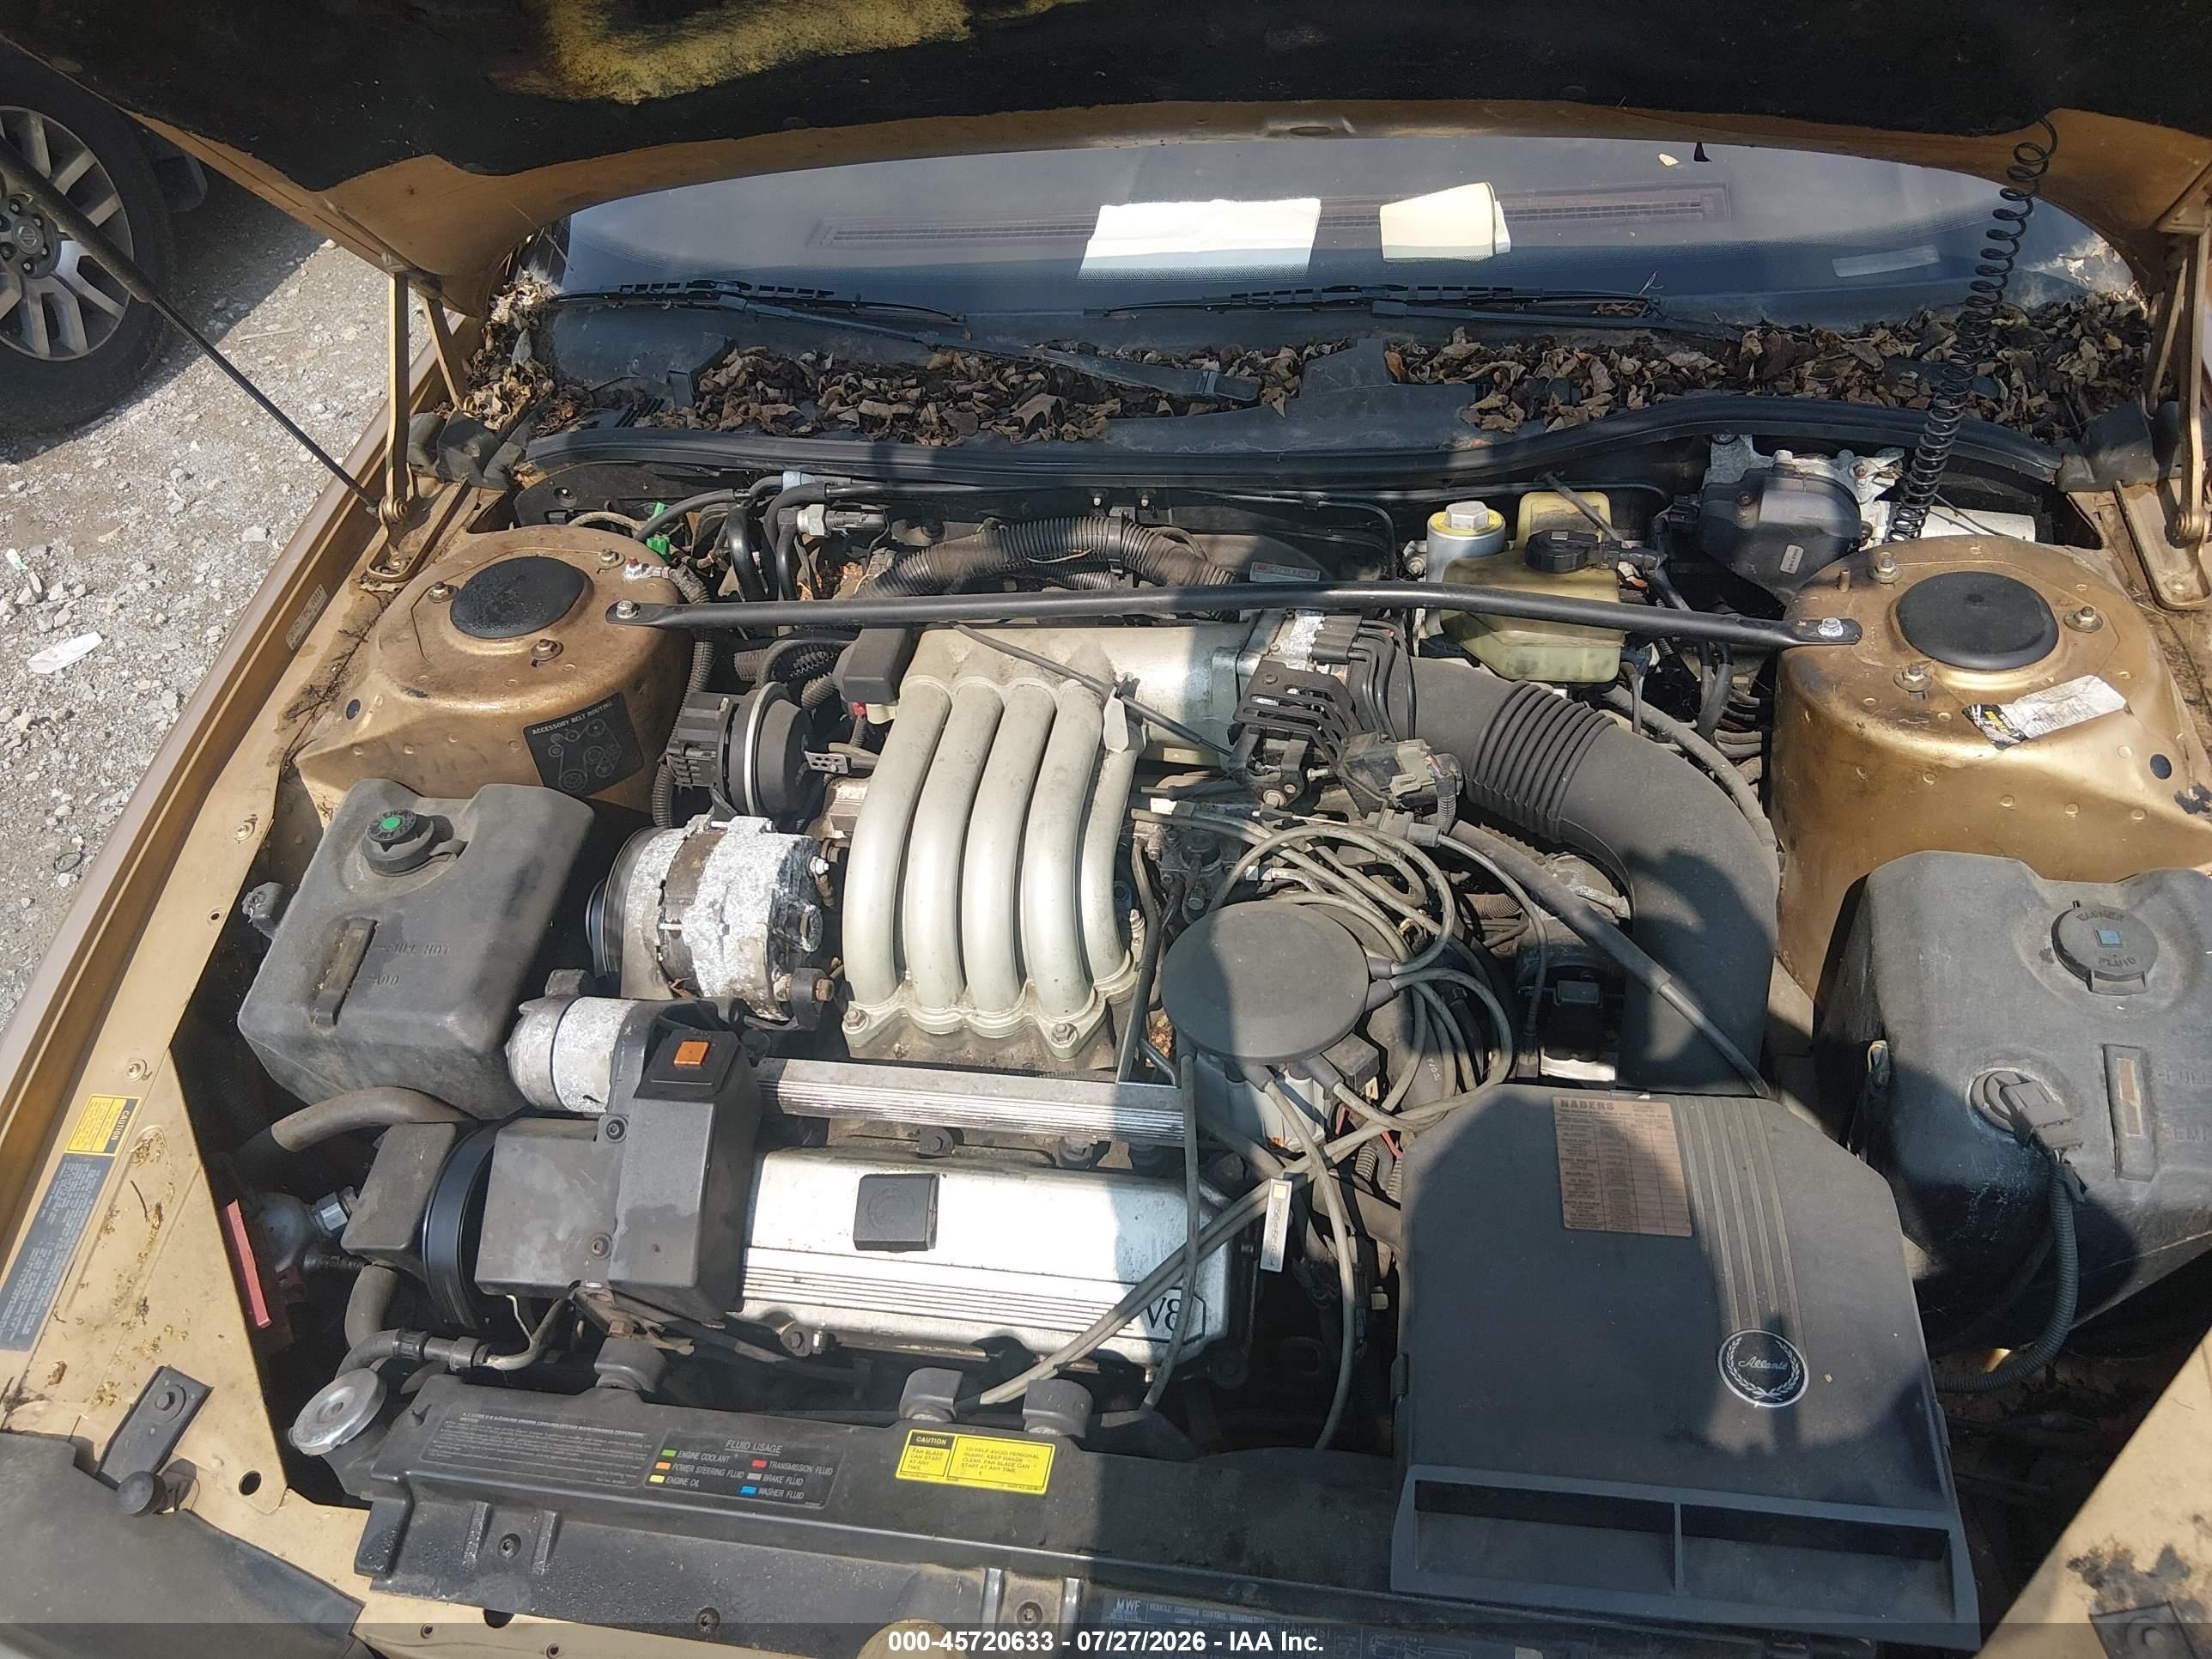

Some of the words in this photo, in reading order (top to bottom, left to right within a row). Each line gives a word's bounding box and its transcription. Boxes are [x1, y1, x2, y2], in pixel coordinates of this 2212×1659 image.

[532, 719, 569, 735] ACCESSORY
[571, 714, 586, 723] BELT
[110, 1109, 131, 1142] CAUTION
[1146, 1297, 1182, 1331] V8
[726, 1439, 751, 1449] FLUID
[752, 1443, 783, 1454] USAGE
[915, 1436, 948, 1445] CAUTION
[677, 1449, 700, 1460] ENGINE
[701, 1452, 731, 1464] COOLANT
[1008, 1449, 1040, 1459] PERSONAL
[672, 1462, 694, 1474] POWER
[695, 1465, 726, 1477] STEERING
[726, 1469, 745, 1480] FLUID
[769, 1460, 814, 1474] TRANSMISSION
[814, 1466, 834, 1476] FLUID
[666, 1476, 689, 1486] ENGINE
[690, 1479, 701, 1488] OIL
[762, 1474, 784, 1485] BRAKE
[785, 1476, 804, 1486] FLUID
[757, 1486, 784, 1498] WASHER
[785, 1490, 805, 1500] FLUID
[1116, 1597, 1141, 1612] MWF
[1201, 1609, 1227, 1621] CONTROL
